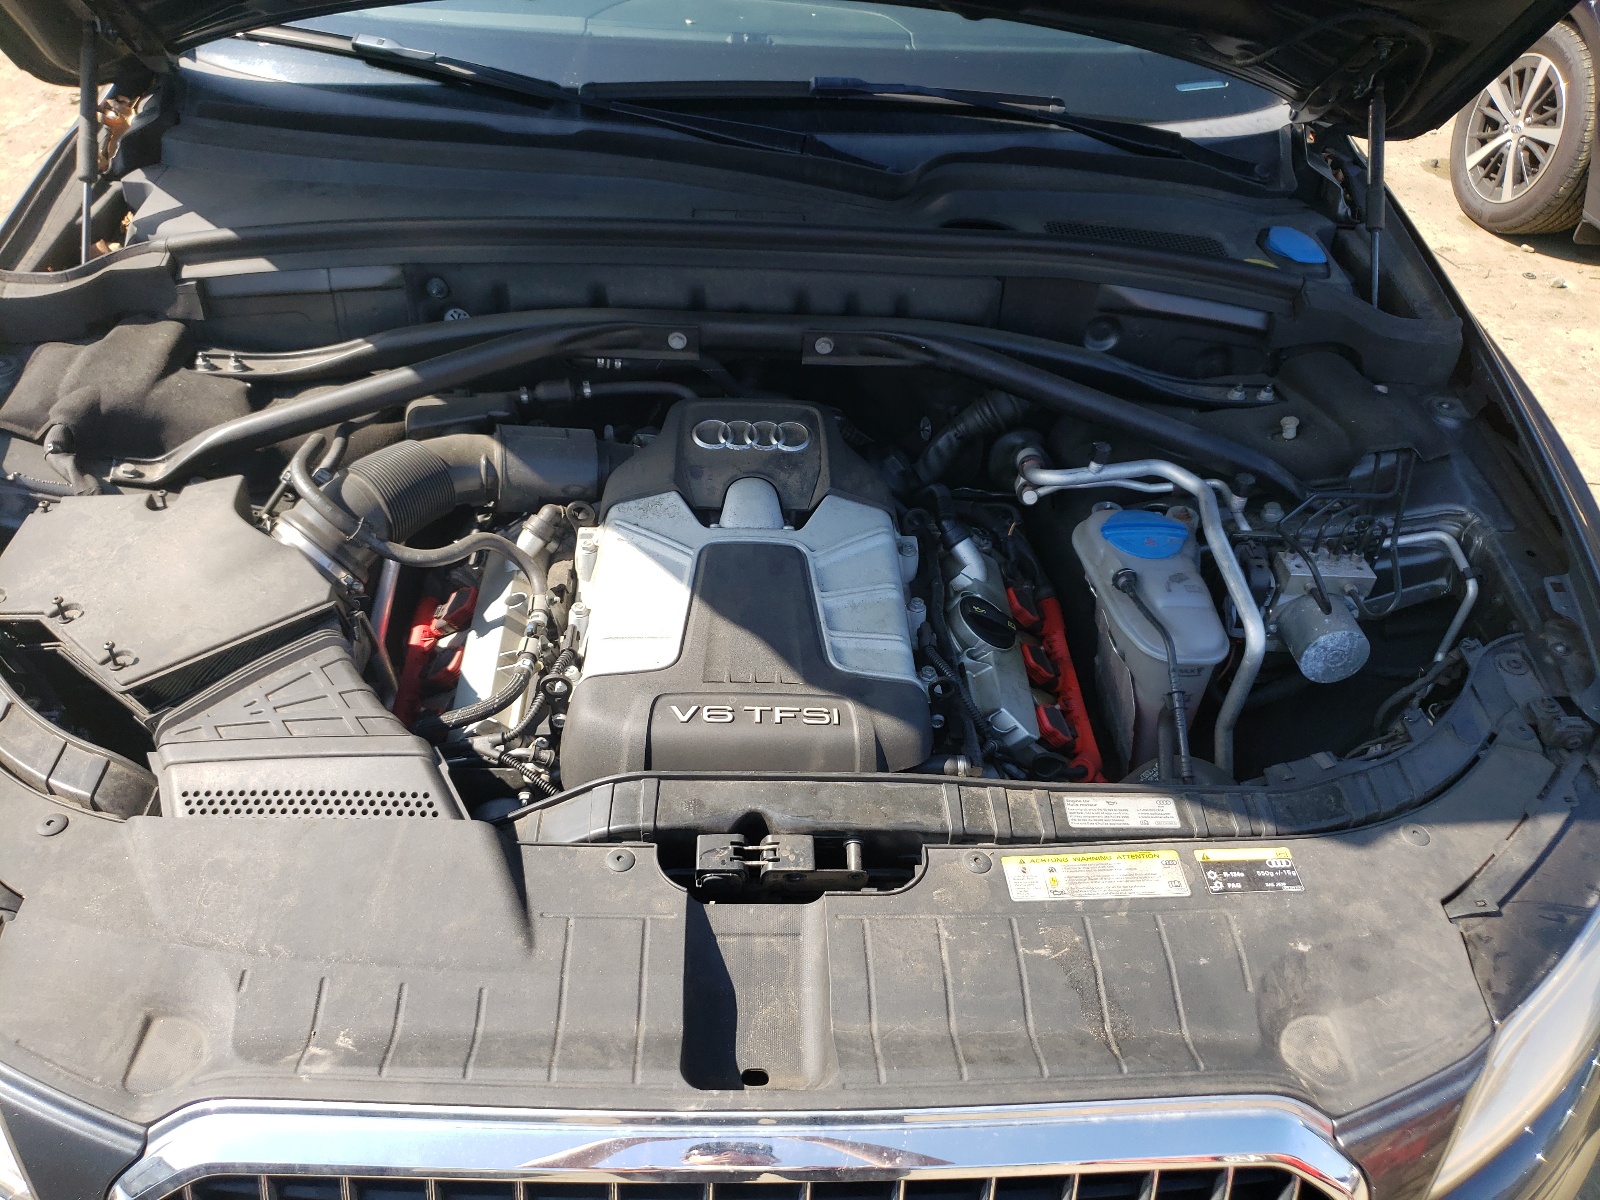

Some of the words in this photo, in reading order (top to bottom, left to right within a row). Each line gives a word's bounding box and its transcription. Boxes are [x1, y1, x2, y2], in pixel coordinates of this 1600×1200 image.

[669, 705, 735, 723] V6
[743, 706, 841, 725] TFSI
[1072, 855, 1113, 863] WARNING
